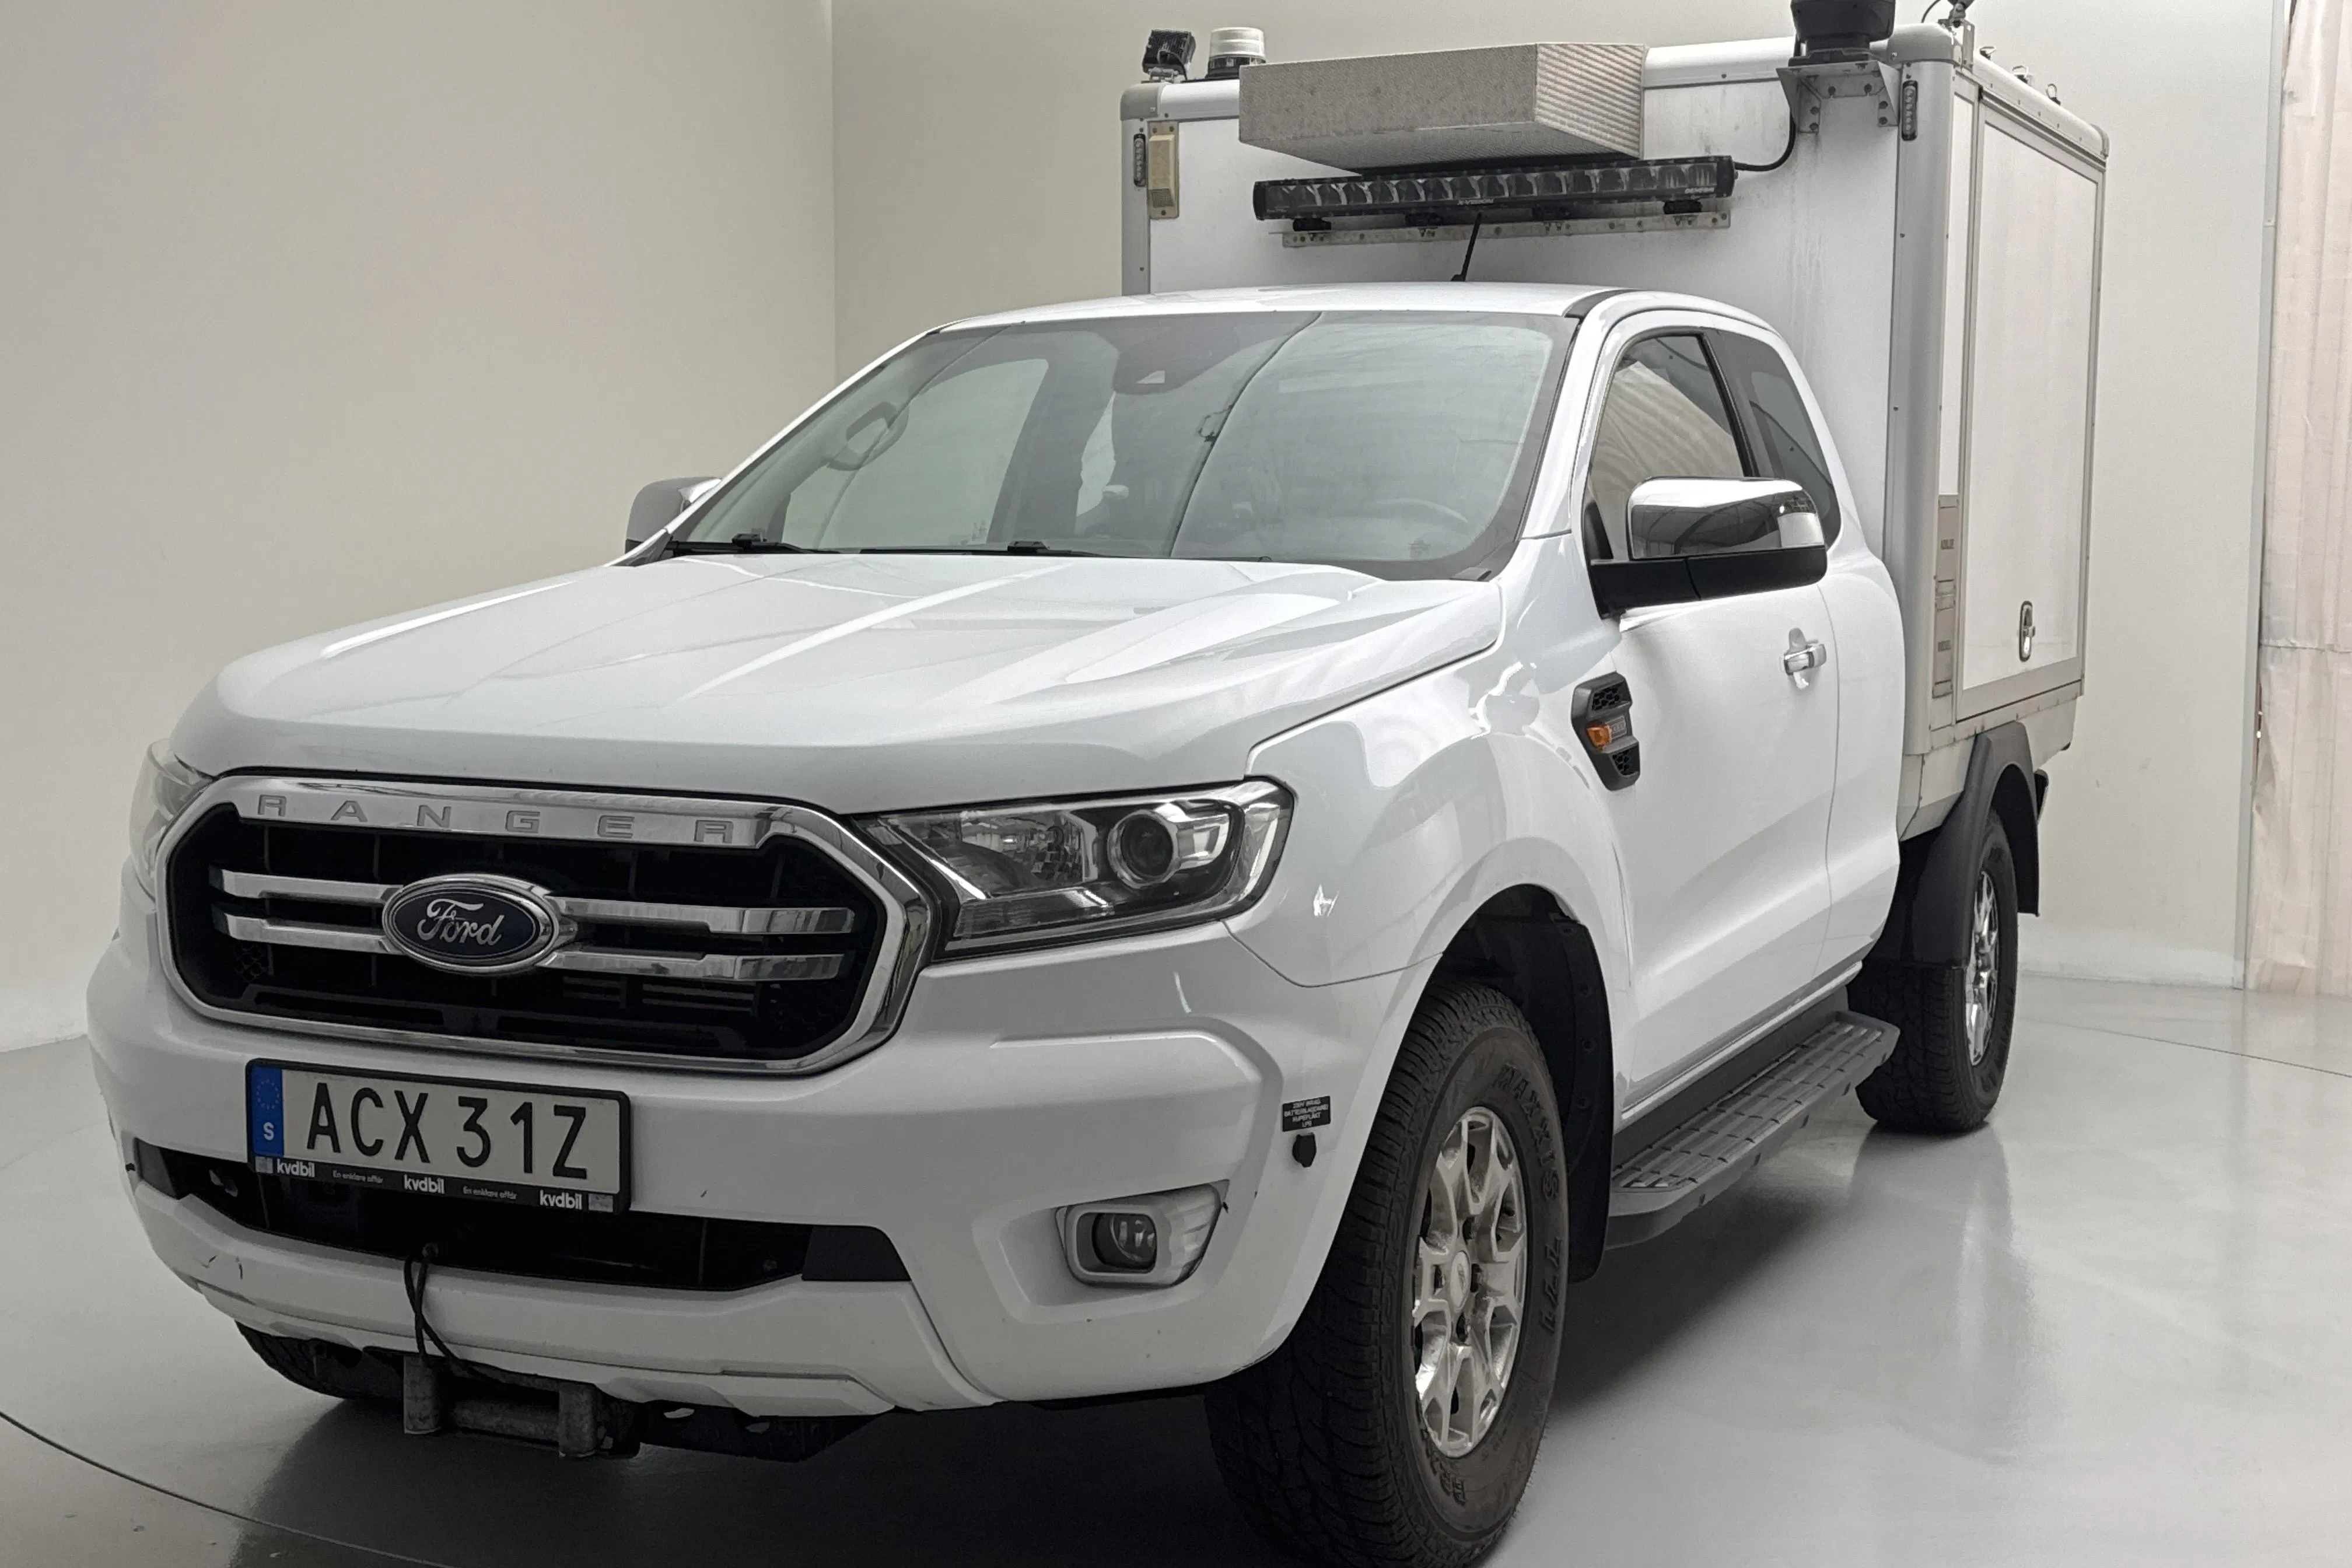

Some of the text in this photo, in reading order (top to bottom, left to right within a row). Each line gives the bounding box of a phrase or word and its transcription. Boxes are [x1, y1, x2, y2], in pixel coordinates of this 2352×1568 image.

[257, 794, 734, 844] RANGER
[417, 898, 505, 946] Ford
[262, 1122, 274, 1140] S
[307, 1082, 589, 1181] ACX 31Z
[1492, 1062, 1559, 1202] MAXXIS
[276, 1158, 316, 1178] kvdbil
[404, 1174, 445, 1195] kvdbil
[540, 1189, 583, 1210] kvdbil
